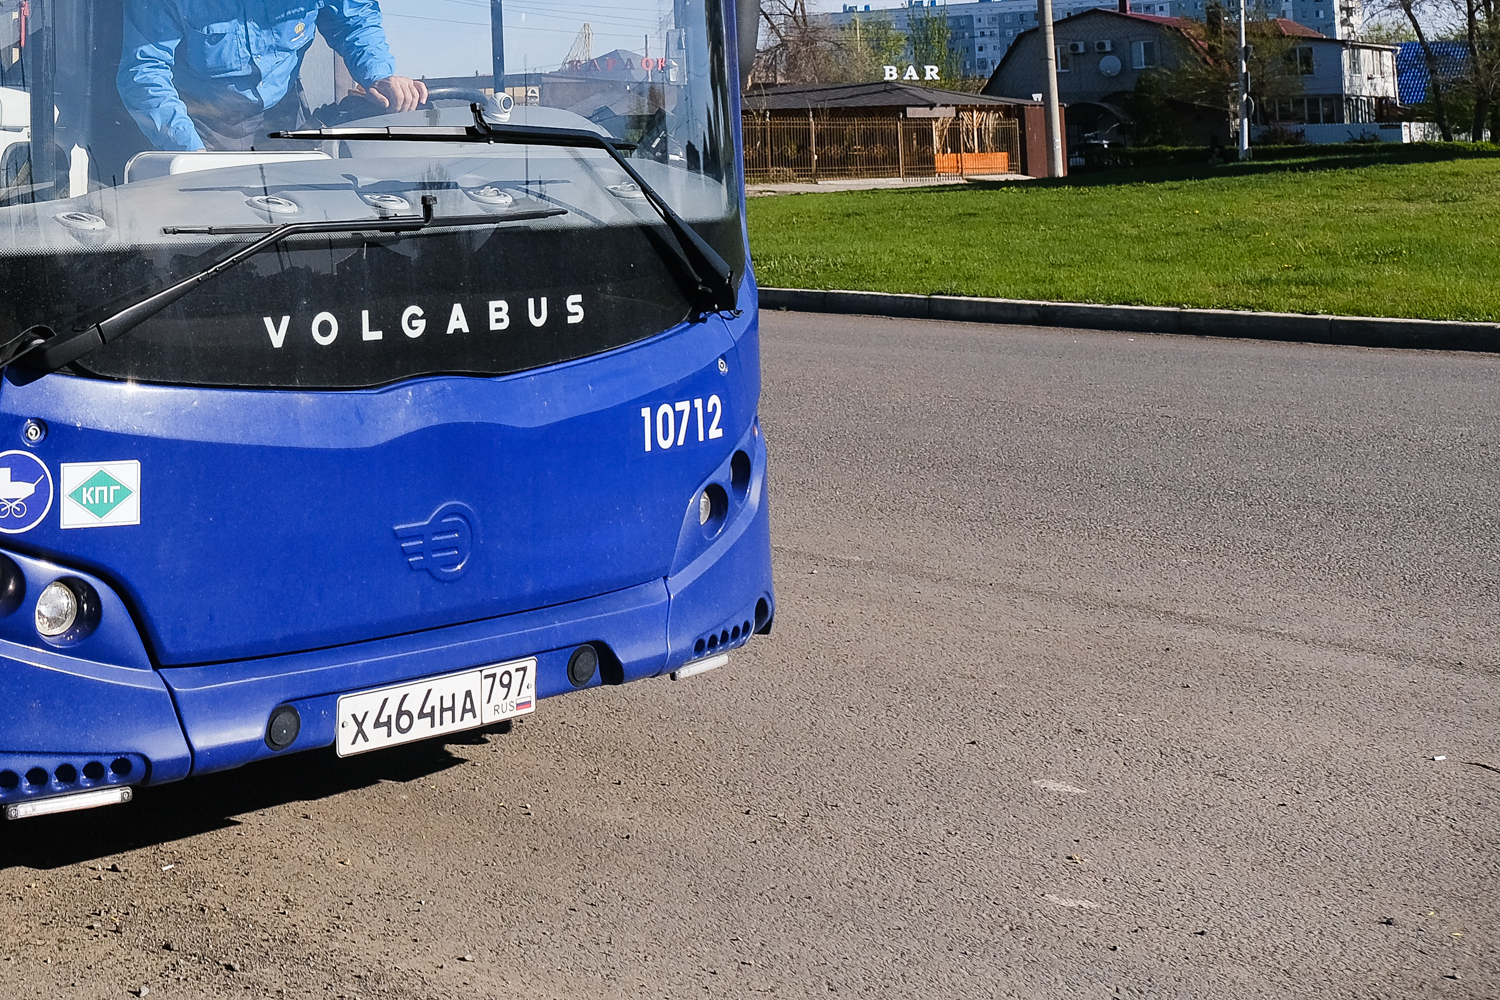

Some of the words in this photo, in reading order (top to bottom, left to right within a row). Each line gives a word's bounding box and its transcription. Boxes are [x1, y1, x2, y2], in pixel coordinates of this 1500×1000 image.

[568, 56, 666, 72] КАРАОК
[883, 65, 940, 80] BAR
[263, 293, 585, 348] VOLGABUS
[641, 394, 723, 452] 10712
[82, 486, 120, 505] КПГ
[483, 665, 528, 705] 797
[493, 700, 515, 716] RUS
